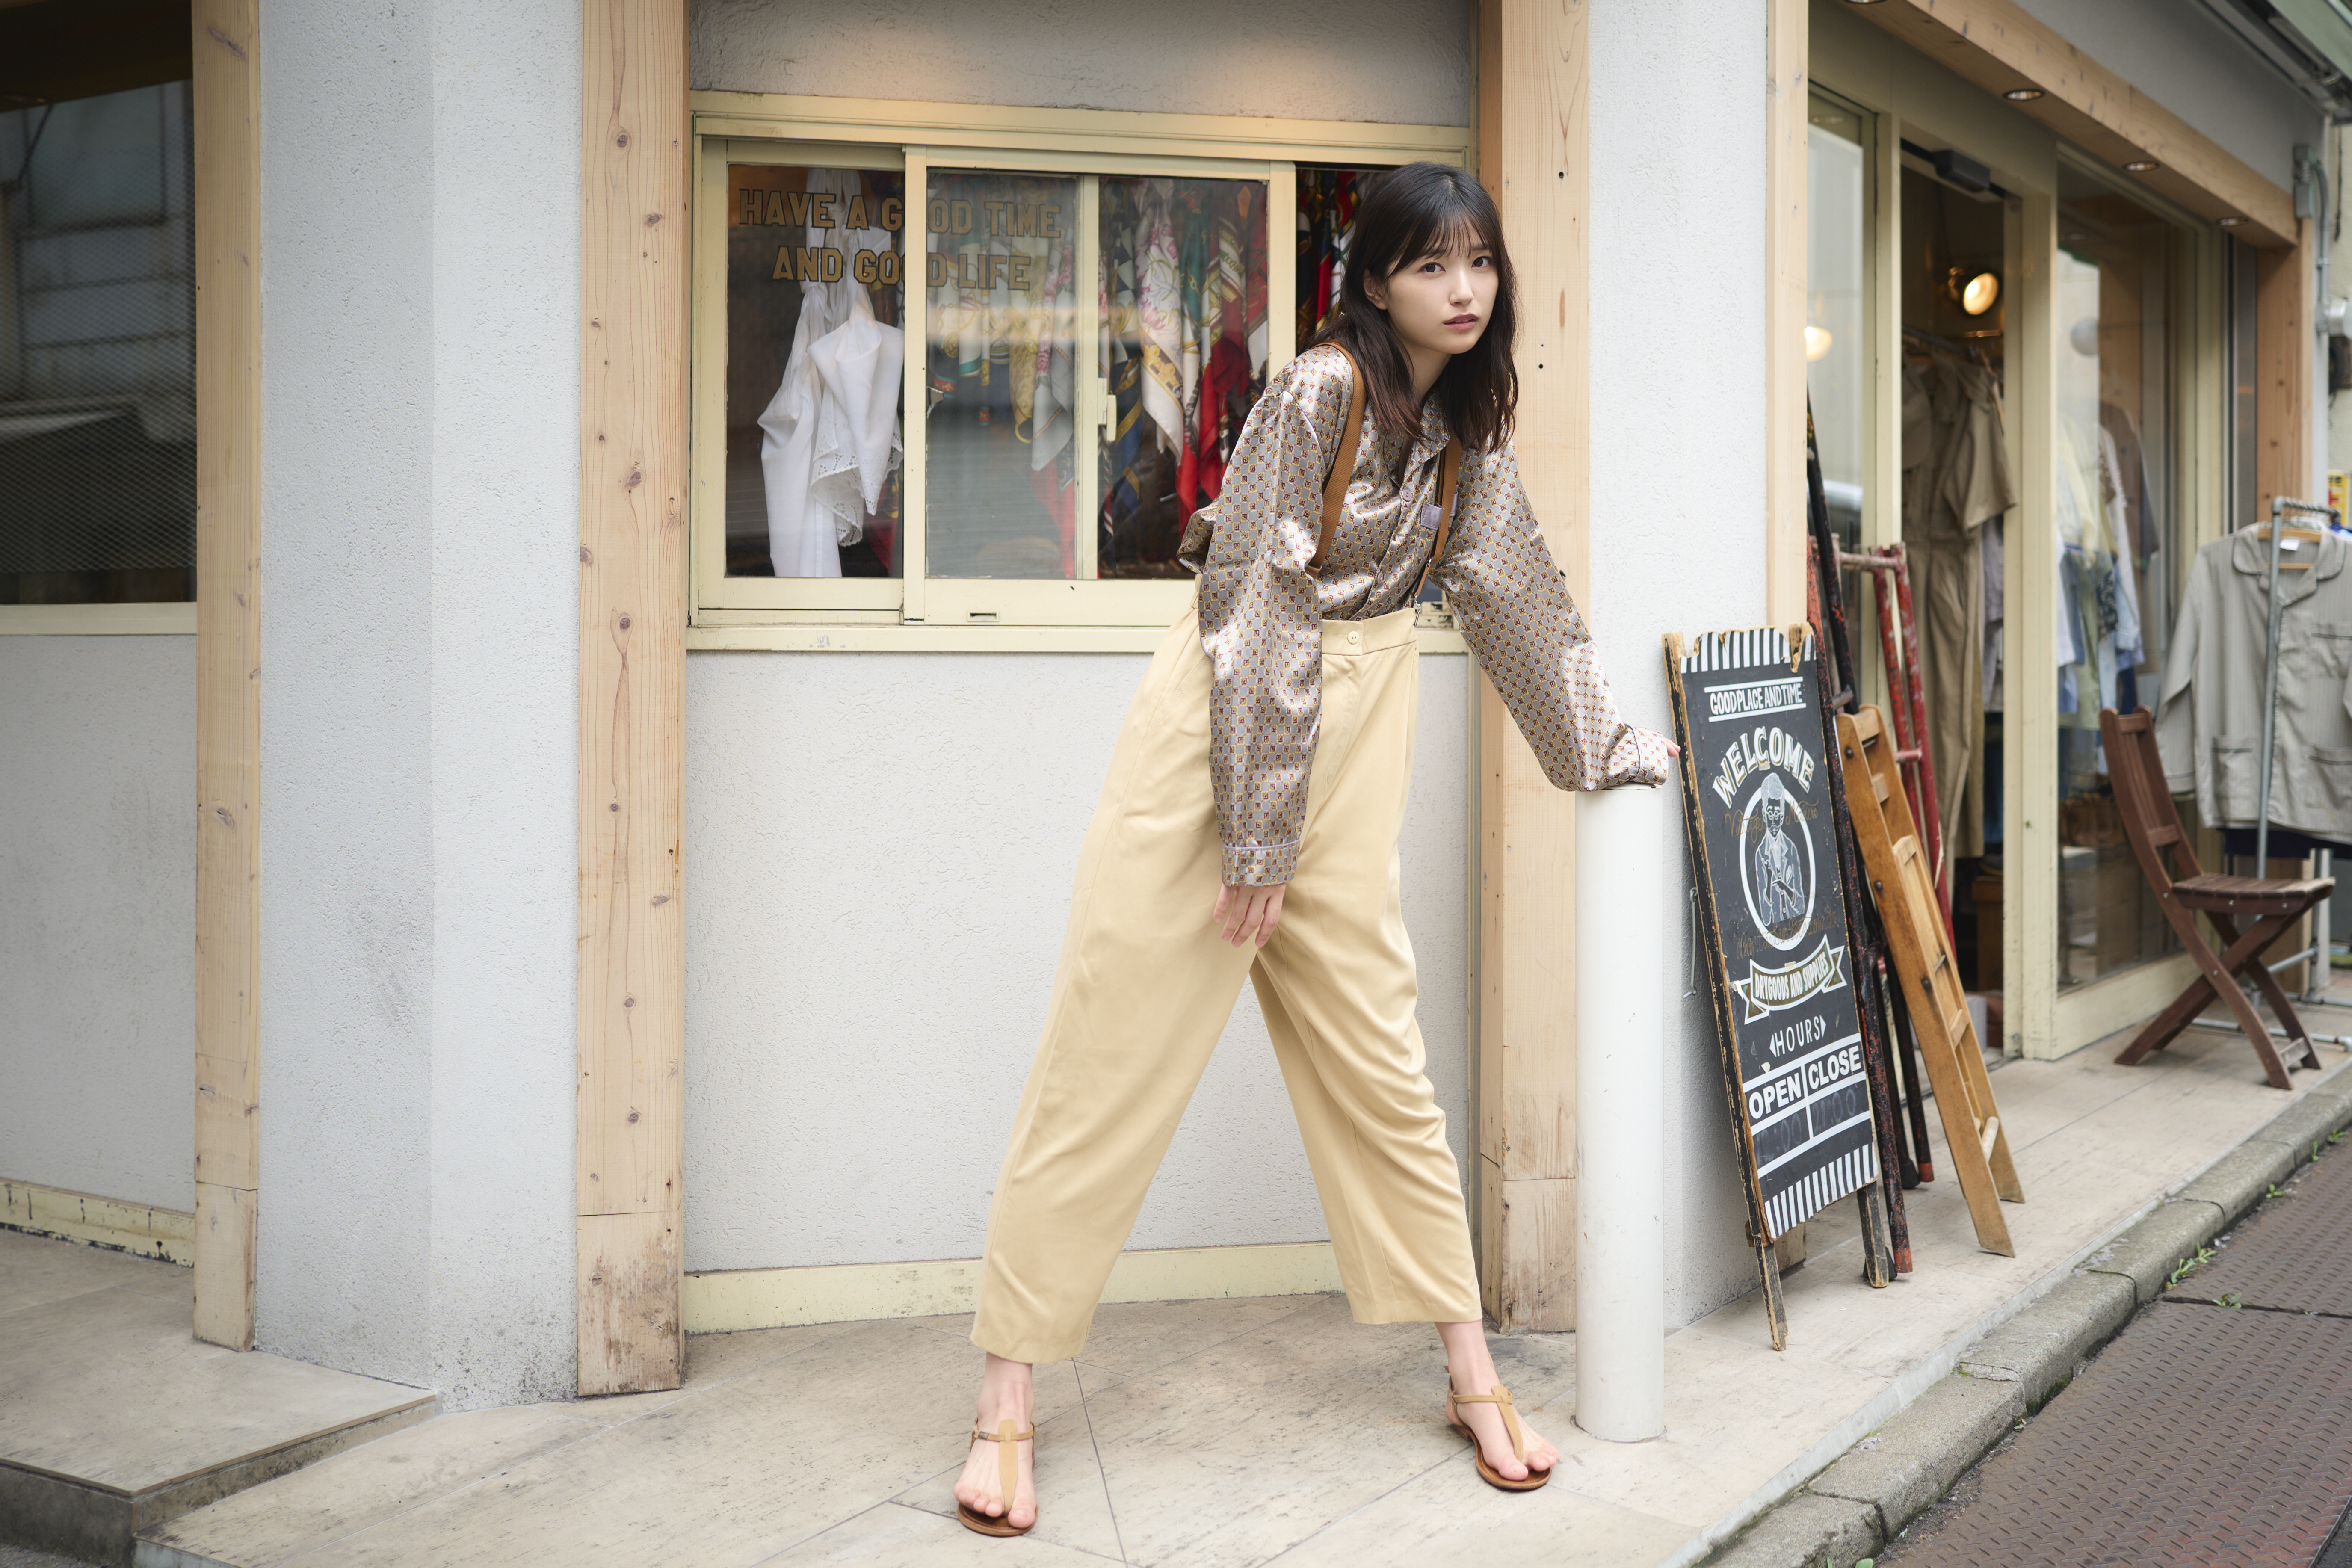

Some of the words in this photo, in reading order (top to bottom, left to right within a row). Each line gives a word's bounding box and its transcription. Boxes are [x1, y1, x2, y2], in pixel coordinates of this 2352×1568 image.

[739, 189, 836, 228] HAVE
[846, 195, 870, 230] A
[881, 197, 973, 234] GOD
[984, 201, 1061, 238] TIME
[772, 246, 843, 283] AND
[854, 249, 948, 287] GOD
[958, 253, 1032, 290] LIFE
[1712, 726, 1814, 809] WELCOME
[1790, 971, 1803, 998] AND
[1802, 951, 1829, 991] SUPPLIES
[1775, 1016, 1820, 1057] HOURS
[1749, 1072, 1802, 1119] OPEN
[1808, 1045, 1861, 1089] CLOSE
